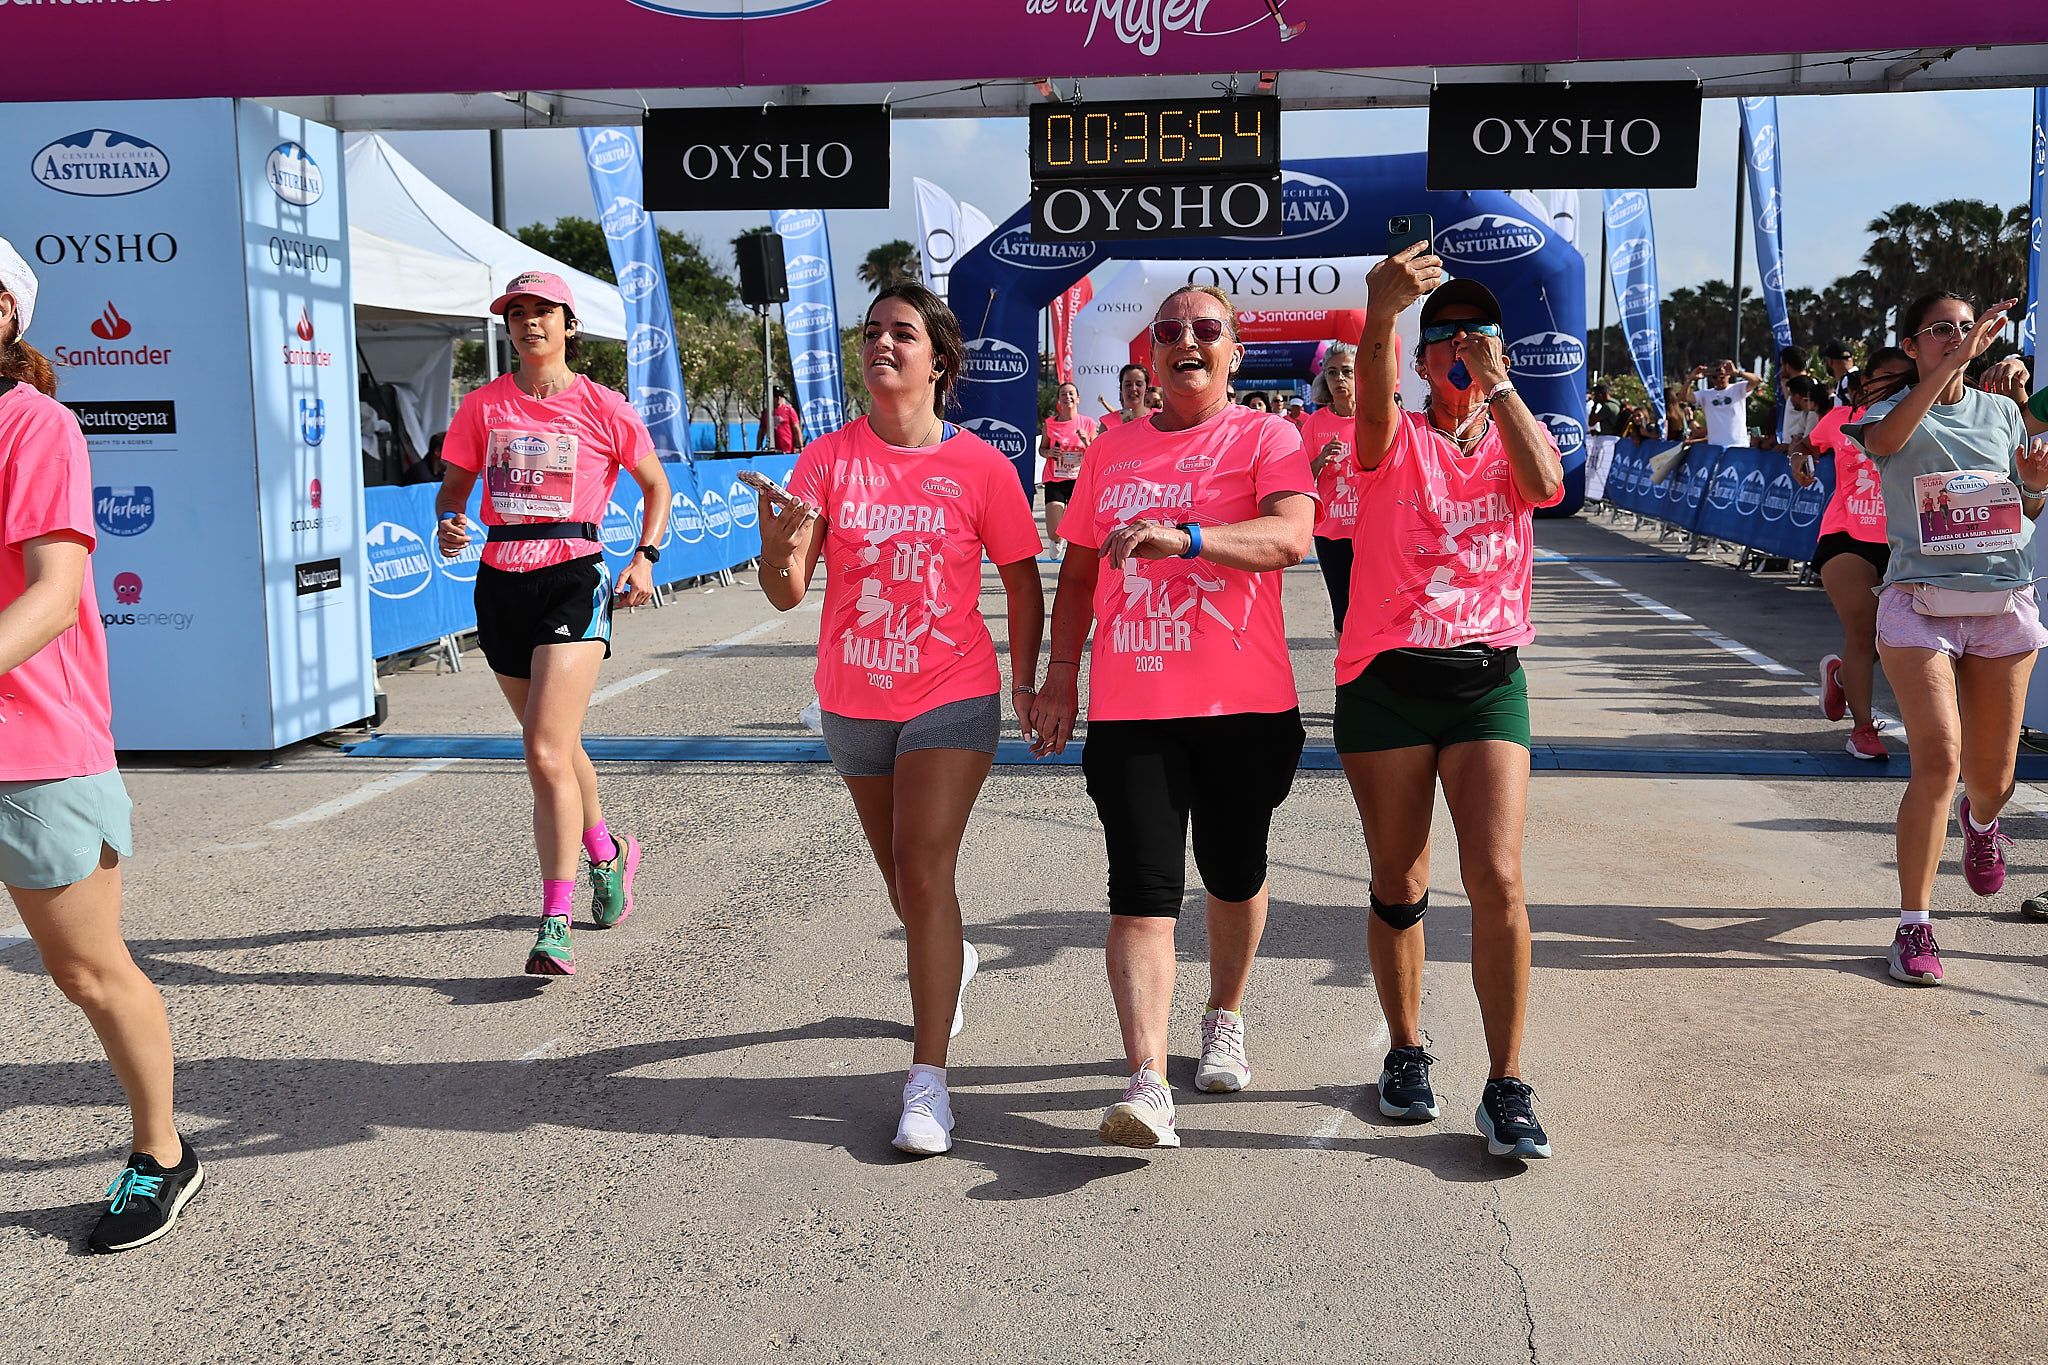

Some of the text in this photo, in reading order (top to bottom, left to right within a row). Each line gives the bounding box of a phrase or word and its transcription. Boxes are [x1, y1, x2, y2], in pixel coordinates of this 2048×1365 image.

[1047, 110, 1261, 166] 00:36:54
[1472, 117, 1661, 155] OYSHO
[42, 154, 161, 180] ASTURIANA
[682, 142, 853, 180] OYSHO
[270, 159, 320, 194] ASTURIANA
[1283, 189, 1330, 198] ECHERA
[1043, 182, 1270, 234] OYSHO
[35, 232, 178, 265] OYSHO
[996, 238, 1087, 258] ASTURIANA
[1441, 234, 1538, 254] ASTURIANA
[269, 236, 328, 273] OYSHO
[1187, 264, 1341, 295] OYSHO
[1097, 303, 1143, 313] OYSHO
[1257, 310, 1328, 322] Santander
[55, 345, 172, 367] Santander
[283, 345, 332, 367] Santander
[1510, 349, 1581, 366] ASTURIANA
[964, 360, 1024, 373] STURIANA
[1078, 364, 1120, 375] OYSHO
[71, 408, 168, 431] Neutrogena
[511, 443, 547, 452] ASTURIANA
[510, 469, 544, 485] 016
[1104, 459, 1142, 476] OYSHO
[841, 473, 885, 487] OYSHO
[925, 483, 959, 497] ASTURIANA
[1949, 482, 1986, 490] ASTURIANA
[97, 497, 152, 524] Marlene
[1330, 502, 1359, 519] MUJE
[1951, 506, 1991, 523] 016
[1932, 543, 1965, 552] OYSHO
[298, 568, 339, 588] Neutrogena
[367, 553, 430, 584] ASTURIANA
[1146, 580, 1173, 618] LA
[1455, 591, 1481, 628] LA
[884, 602, 909, 642] LA
[1113, 620, 1192, 654] MUJER
[843, 637, 920, 674] MUJER
[1135, 656, 1164, 672] 2026
[867, 672, 894, 689] 2026
